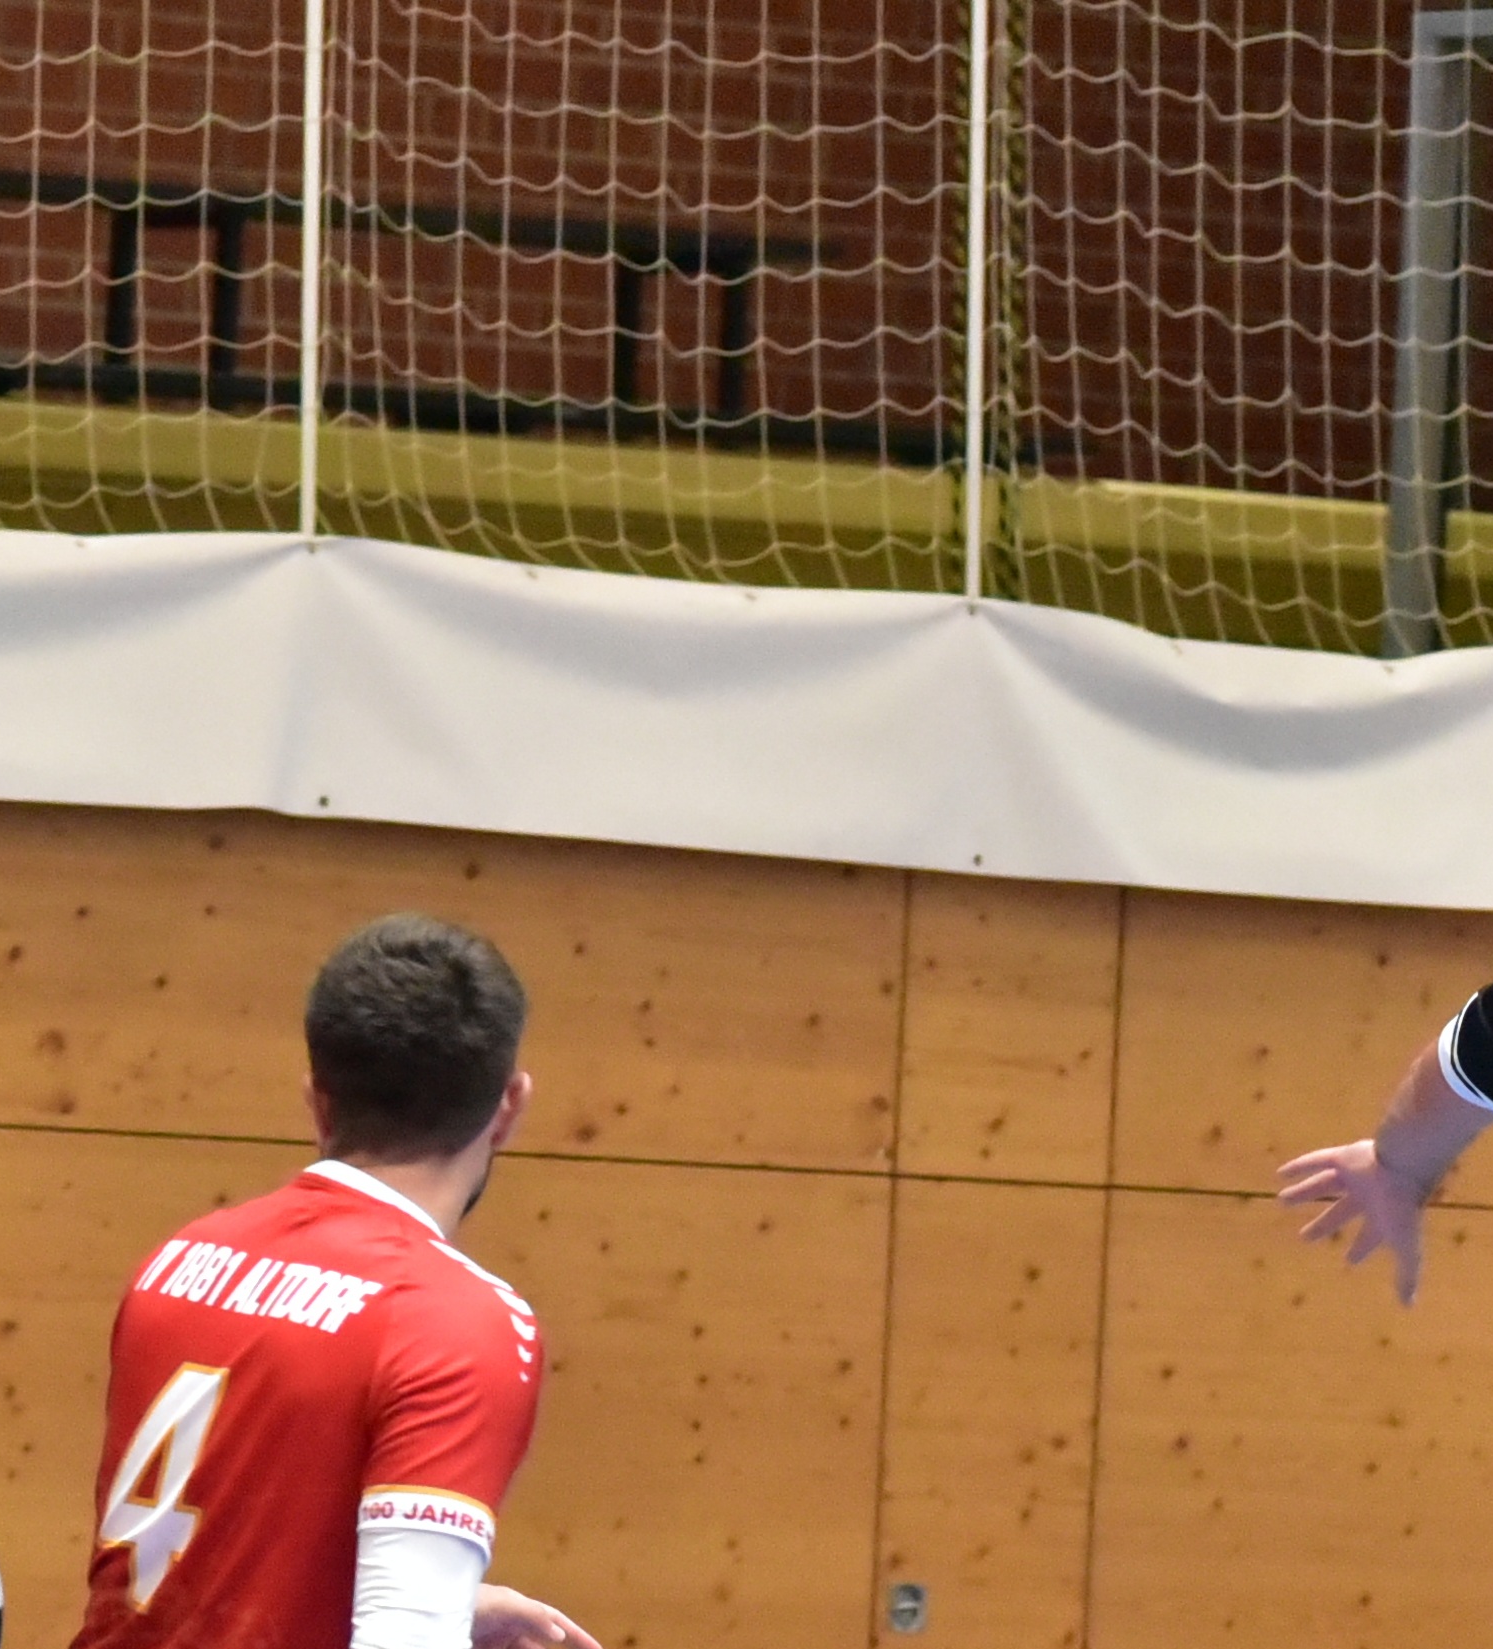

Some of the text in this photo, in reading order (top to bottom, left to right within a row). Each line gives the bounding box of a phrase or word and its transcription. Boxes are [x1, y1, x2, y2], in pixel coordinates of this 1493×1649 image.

[159, 1241, 248, 1307] 1881
[221, 1257, 386, 1334] ALTDORF
[97, 1361, 230, 1615] 4
[402, 1502, 486, 1538] JAHRE
